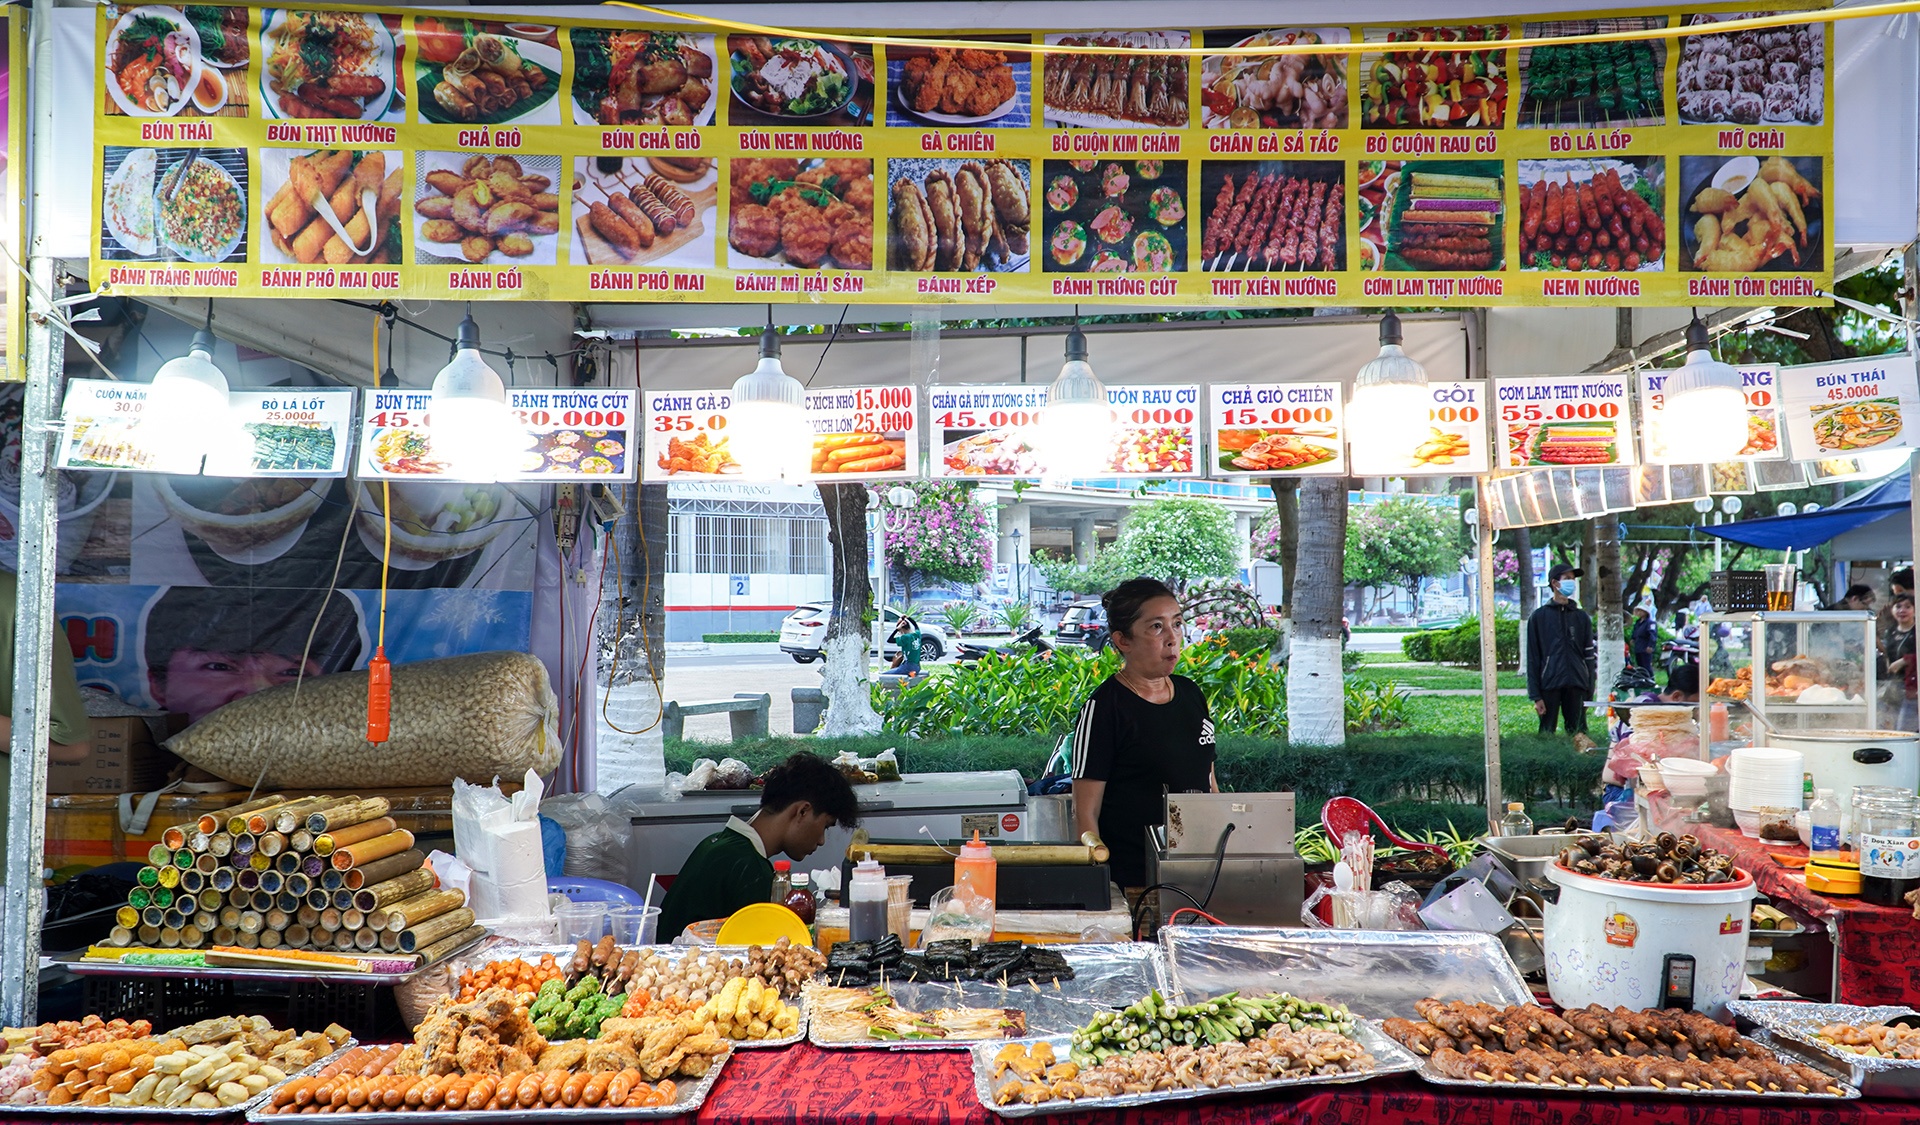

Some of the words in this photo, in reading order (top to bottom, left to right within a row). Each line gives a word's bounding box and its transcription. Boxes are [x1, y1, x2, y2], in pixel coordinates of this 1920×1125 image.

[142, 120, 173, 140] BÚN
[179, 121, 212, 140] THÁI
[267, 120, 300, 142] BÚN
[305, 125, 337, 145] THỊT
[342, 122, 396, 143] NƯỚNG
[458, 125, 490, 147] CHẢ
[495, 127, 521, 148] GIÒ
[602, 129, 635, 149] BÚN
[639, 127, 671, 149] CHẢ
[674, 129, 701, 149] GIÒ
[740, 130, 770, 150] BÚN
[775, 133, 807, 150] NEM
[811, 130, 863, 151] NƯỚNG
[922, 130, 943, 151] GÀ
[947, 131, 995, 151] CHIÊN
[1210, 132, 1253, 152] CHÂN
[1257, 131, 1278, 152] GÀ
[1284, 130, 1305, 152] SẢ
[1309, 129, 1339, 152] TẮC
[1550, 132, 1572, 151] BÒ
[1577, 130, 1597, 150] LÁ
[1601, 129, 1632, 149] LỐP
[1718, 128, 1745, 149] MỠ
[1748, 130, 1784, 149] CHÀI
[1052, 131, 1070, 152] BÒ
[1073, 132, 1110, 155] CUỘN
[1112, 135, 1138, 152] KIM
[1141, 132, 1180, 152] CHÂM
[1366, 132, 1387, 153] BÒ
[1392, 132, 1435, 156] CUỘN
[1440, 136, 1470, 153] RAU
[1475, 131, 1497, 153] CỦ
[110, 265, 145, 284] BÁNH
[194, 267, 238, 287] NƯỚNG
[262, 268, 300, 288] BÁNH
[305, 268, 334, 288] PHÔ
[339, 272, 367, 288] MAI
[371, 272, 399, 290] QUE
[450, 269, 492, 289] BÁNH
[496, 266, 522, 289] GỐI
[590, 269, 633, 290] BÁNH
[638, 271, 668, 290] PHÔ
[673, 274, 705, 291] MAI
[735, 273, 776, 291] BÁNH
[780, 273, 800, 292] MÌ
[803, 271, 828, 292] HẢI
[832, 272, 863, 292] SẢN
[917, 275, 962, 293] BÁNH
[966, 273, 997, 294] XẾP
[1052, 276, 1092, 295] BÁNH
[1097, 276, 1145, 295] TRỨNG
[1149, 276, 1178, 296] CÚT
[1211, 280, 1242, 298] THỊT
[1245, 275, 1281, 296] XIÊN
[1284, 275, 1337, 296] NƯỚNG
[1544, 280, 1580, 296] NEM
[1585, 276, 1640, 296] NƯỚNG
[1689, 277, 1730, 296] BÁNH
[1733, 276, 1765, 296] TÔM
[1769, 276, 1813, 296] CHIÊN
[1364, 278, 1393, 296] CƠM
[1397, 279, 1424, 296] LAM
[1427, 279, 1455, 299] THỊT
[1458, 276, 1503, 296] NƯỚNG
[1816, 373, 1846, 387] BÚN
[1851, 368, 1885, 383] THÁI
[375, 390, 403, 409] BÚN
[512, 391, 548, 408] BÁNH
[552, 391, 598, 408] TRỨNG
[601, 391, 629, 408] CÚT
[813, 392, 834, 409] XÍCH
[836, 390, 855, 409] NHỎ
[855, 387, 912, 410] 15.000
[932, 391, 957, 409] CHÂN
[959, 390, 972, 408] GÀ
[974, 390, 990, 408] RÚT
[992, 393, 1023, 407] XƯƠNG
[1025, 388, 1037, 407] SẢ
[1143, 390, 1172, 404] RAU
[1222, 385, 1253, 404] CHẢ
[1257, 386, 1283, 403] GIÒ
[1288, 385, 1333, 403] CHIÊN
[1433, 383, 1475, 402] GỐI
[1499, 386, 1524, 400] CƠM
[1527, 385, 1551, 399] LAM
[1554, 385, 1579, 402] THỊT
[1582, 380, 1623, 398] NƯỚNG
[1828, 384, 1878, 400] 45.000đ
[262, 398, 278, 410] BÒ
[283, 398, 297, 410] LÁ
[302, 397, 325, 410] LỐT
[653, 393, 692, 411] CÁNH
[1502, 402, 1619, 421] 55.000
[266, 412, 315, 420] 25.000đ
[511, 410, 625, 426] 30.000
[854, 411, 913, 433] 25.000
[1222, 407, 1333, 425] 15.000
[737, 581, 744, 595] 2
